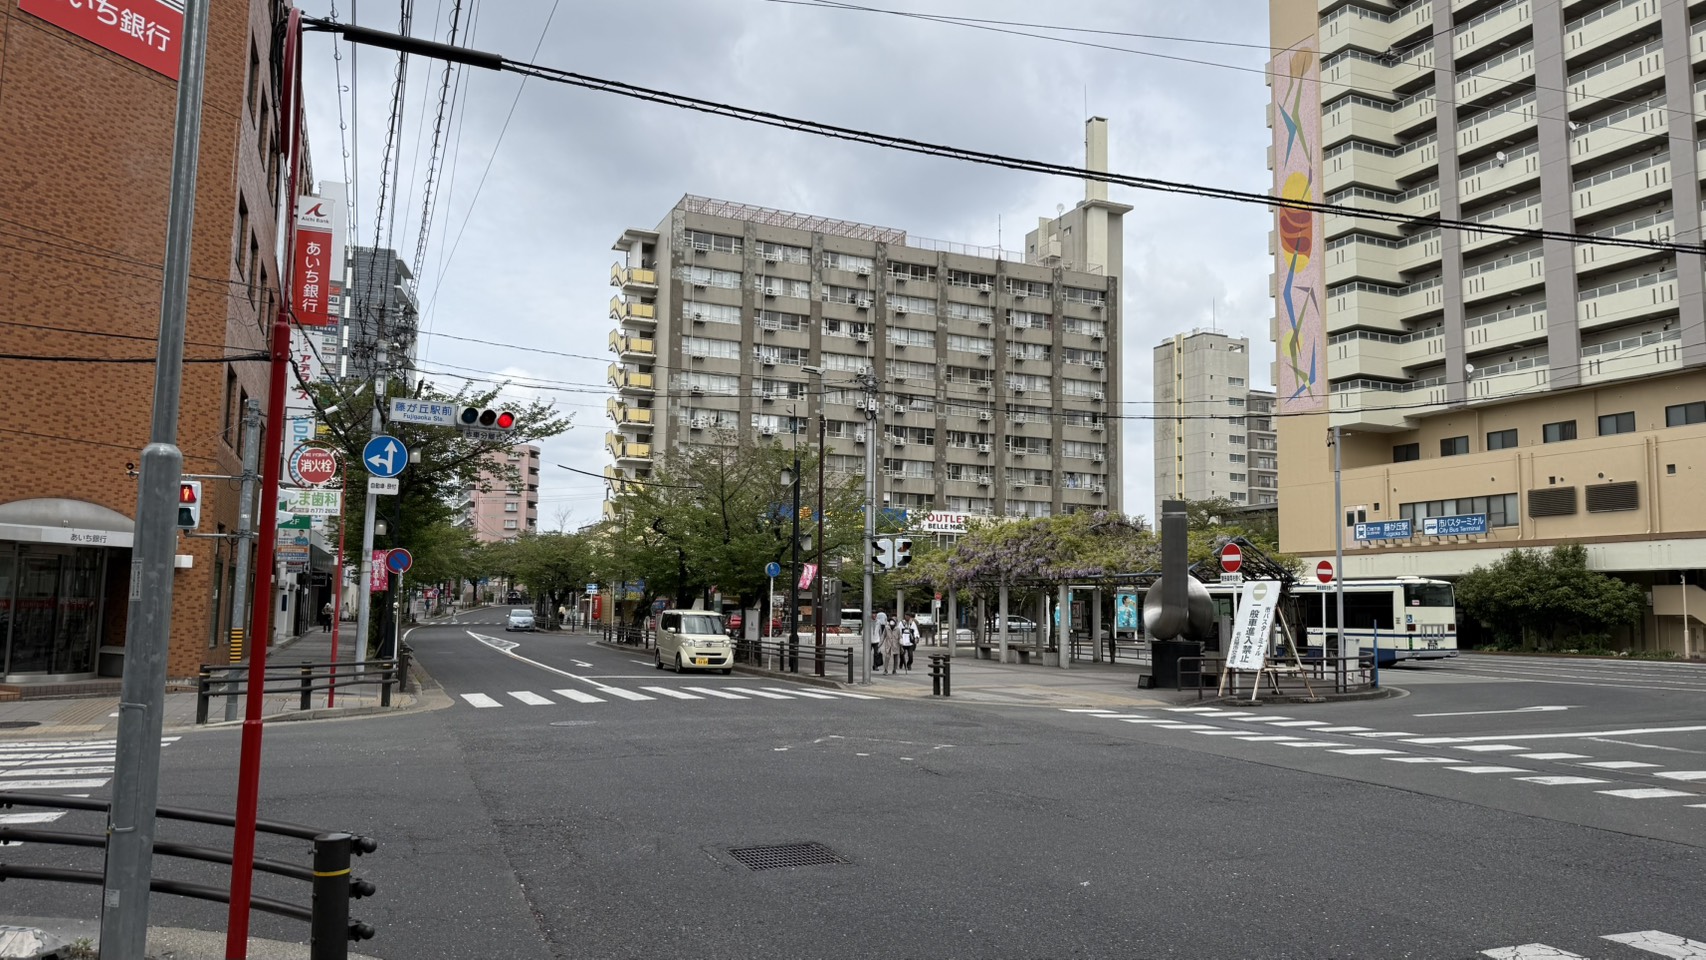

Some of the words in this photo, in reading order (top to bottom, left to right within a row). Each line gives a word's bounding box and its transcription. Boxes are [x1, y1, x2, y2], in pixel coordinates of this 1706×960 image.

[302, 241, 321, 312] あいち銀行
[395, 401, 452, 416] 藤が丘駅前
[403, 412, 431, 421] Fujigaoka
[301, 459, 332, 472] 消火栓
[289, 518, 300, 526] 2F
[1384, 521, 1409, 531] 藤が丘駅
[1439, 516, 1484, 528] 市バスターミナル
[71, 534, 107, 543] あいち銀行
[1239, 603, 1261, 663] 一般車進入禁止
[1255, 606, 1271, 656] 市バスターミナル
